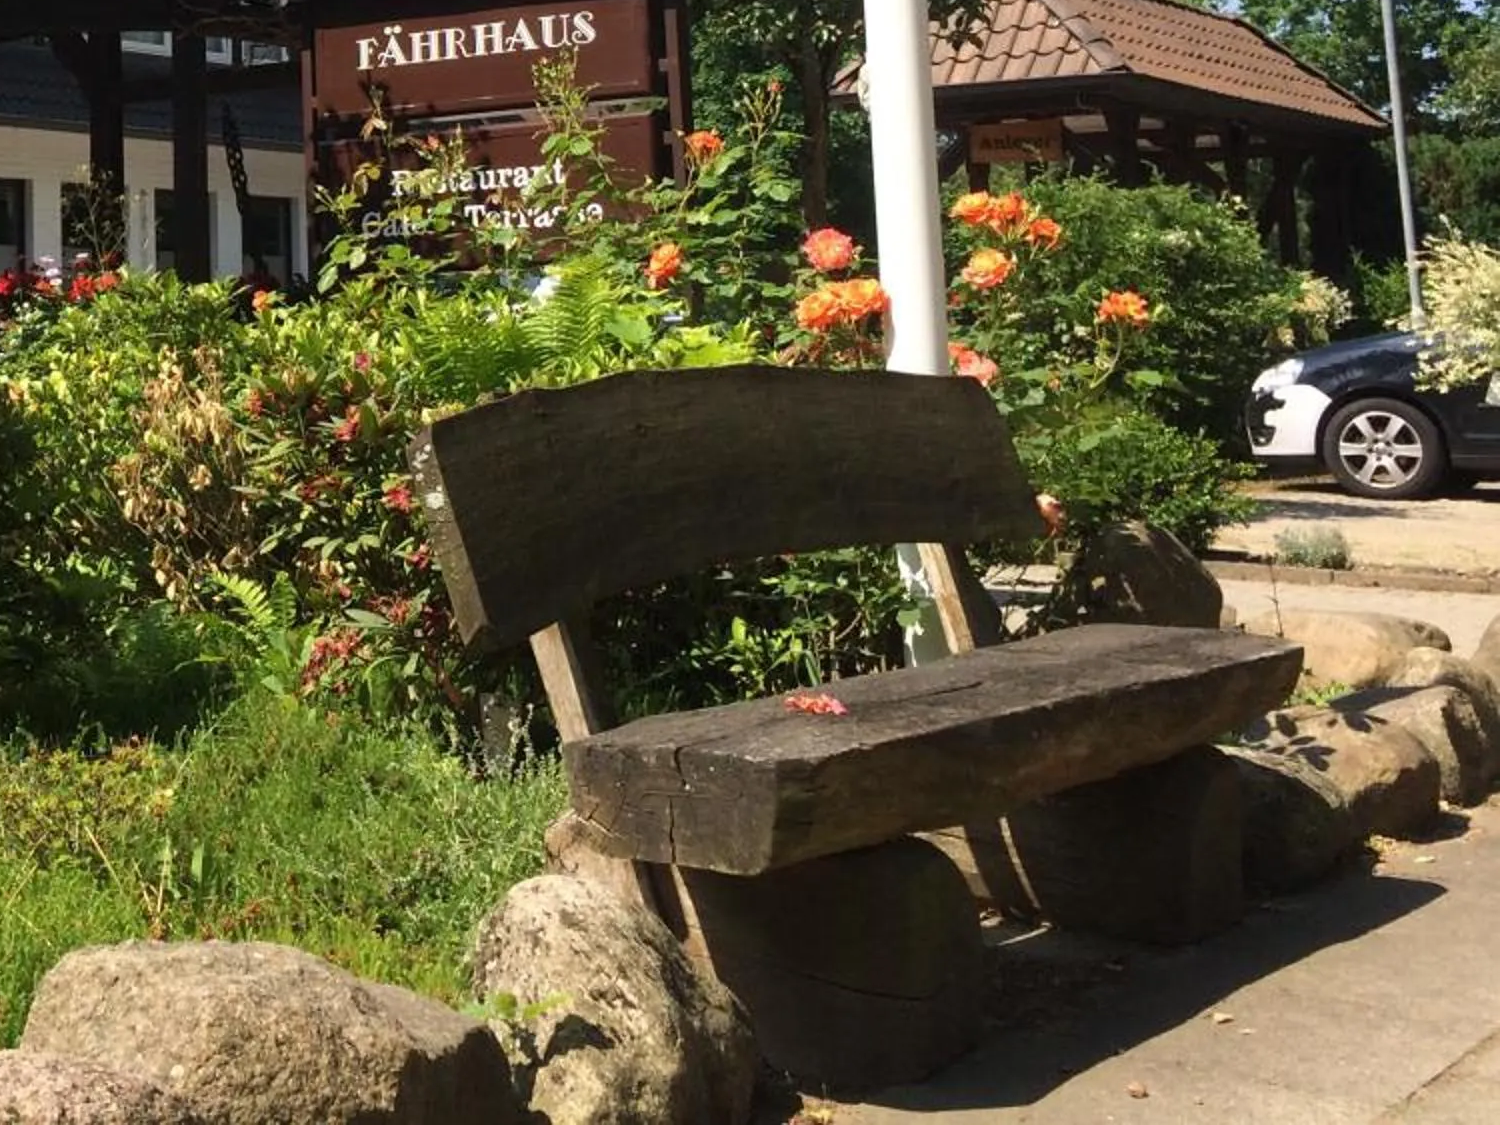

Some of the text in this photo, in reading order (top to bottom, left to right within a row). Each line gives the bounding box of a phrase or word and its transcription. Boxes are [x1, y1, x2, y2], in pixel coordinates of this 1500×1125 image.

[356, 11, 598, 70] FÄHRHAUS
[392, 157, 566, 196] Rtaurant
[464, 202, 605, 229] Terrase
